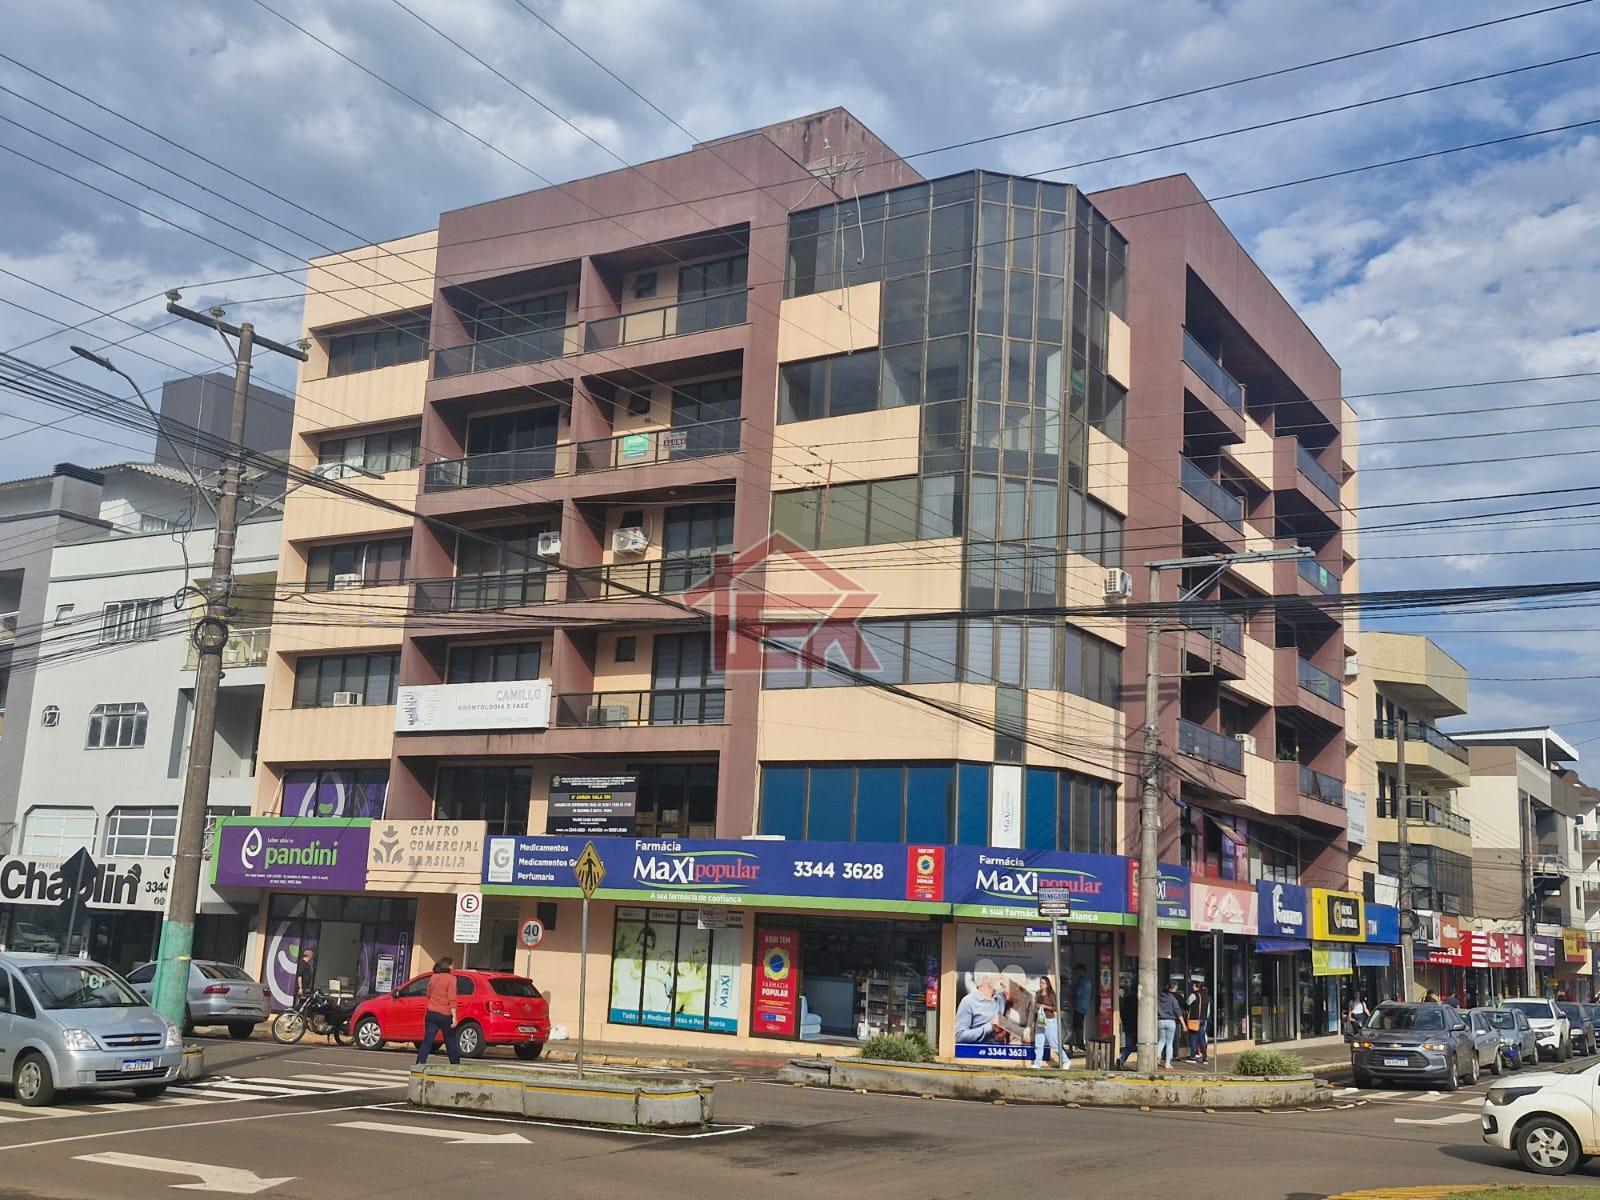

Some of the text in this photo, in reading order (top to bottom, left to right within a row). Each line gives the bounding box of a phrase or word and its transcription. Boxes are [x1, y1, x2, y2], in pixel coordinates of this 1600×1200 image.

[496, 687, 542, 701] CAMILLO
[410, 825, 459, 836] CENTRO
[409, 840, 480, 852] COMERCIAL
[519, 843, 569, 852] Medicamentos
[635, 840, 681, 851] Farmácia
[264, 840, 338, 869] pandini
[408, 855, 466, 868] BRASILIA
[518, 858, 568, 867] Medicamentos
[979, 854, 1025, 867] Farmácia
[694, 859, 760, 882] popular
[793, 861, 884, 880] 3344 3628
[517, 872, 555, 881] Perfumaria
[466, 898, 473, 909] E
[1005, 908, 1038, 918] farmáci
[524, 924, 540, 937] 40
[762, 988, 789, 997] POPULAR
[988, 1048, 1007, 1056] 3344
[1008, 1048, 1028, 1057] 3628
